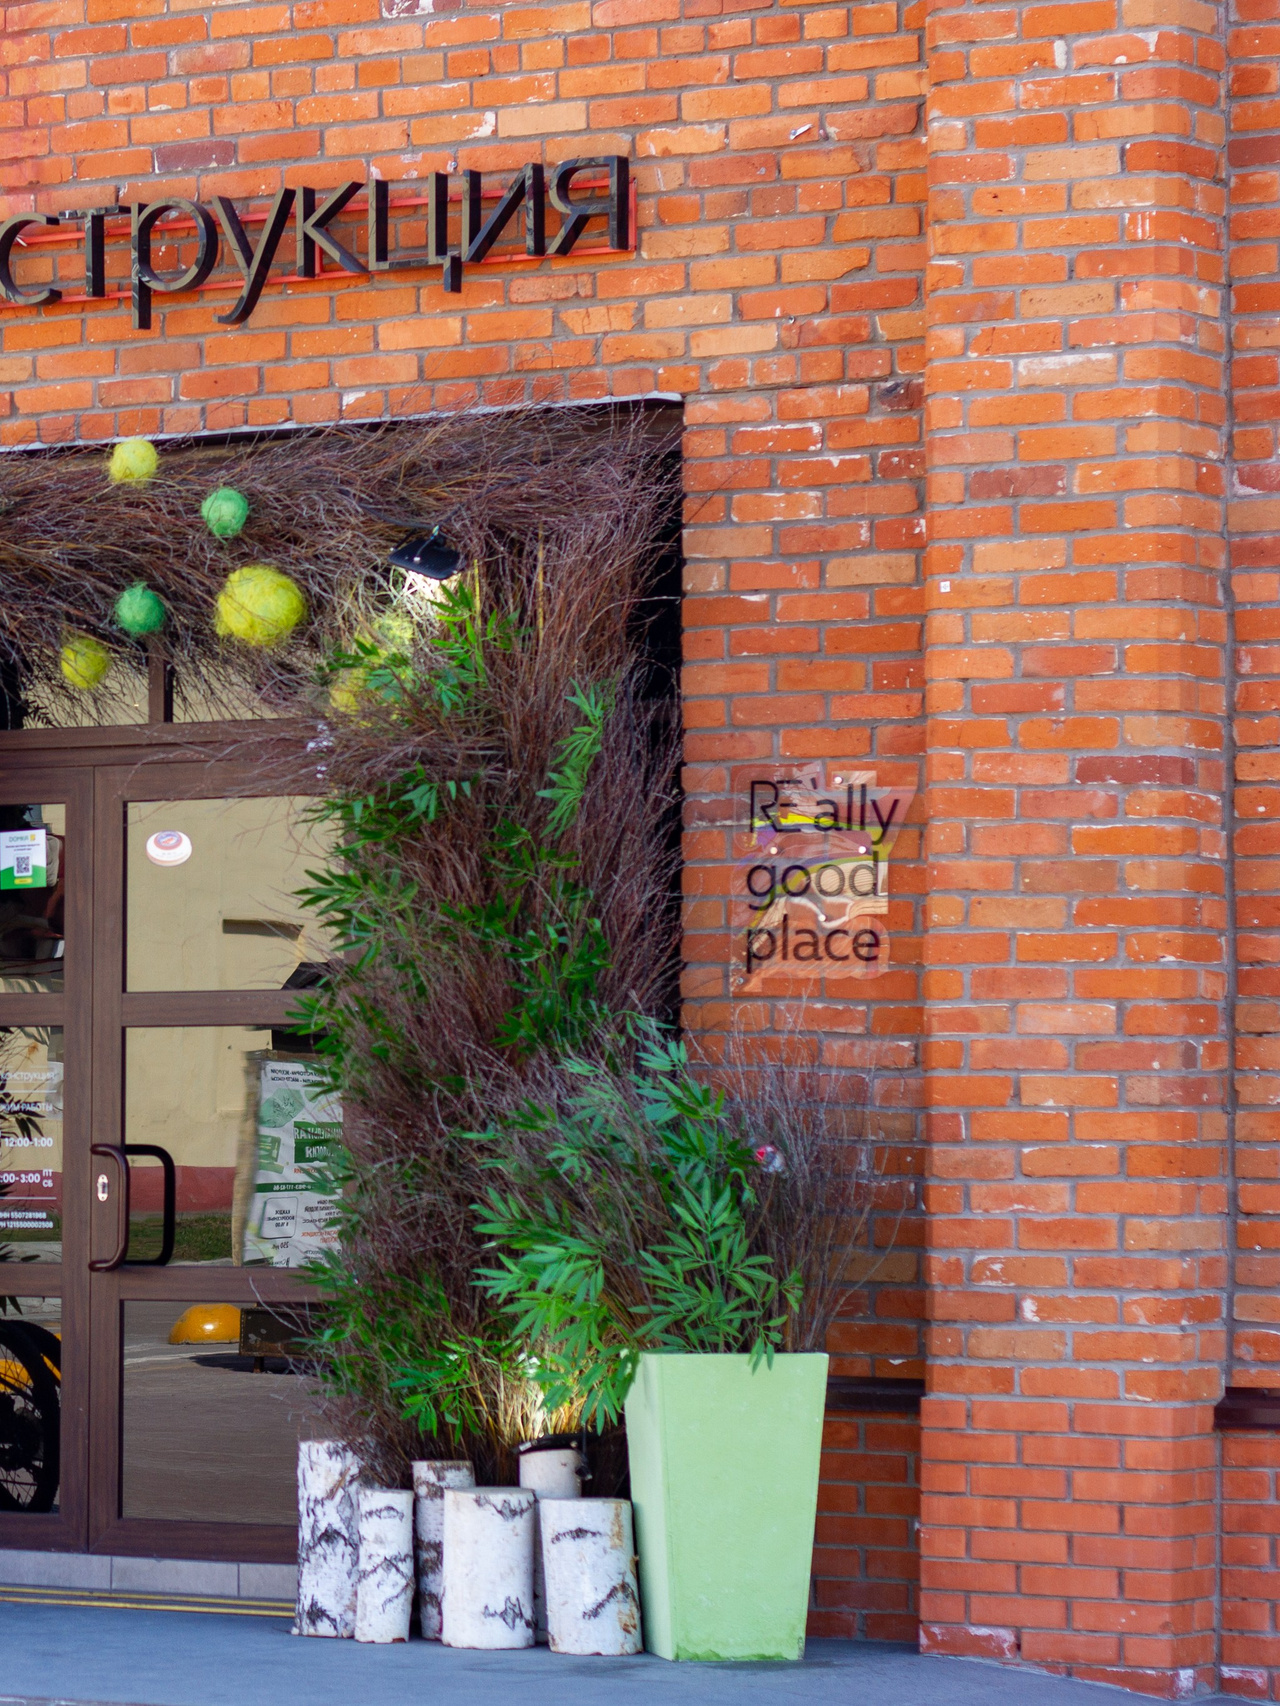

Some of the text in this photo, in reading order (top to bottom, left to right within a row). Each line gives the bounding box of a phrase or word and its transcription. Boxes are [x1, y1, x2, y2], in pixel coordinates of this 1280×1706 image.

[746, 850, 879, 911] good
[745, 913, 881, 974] place
[21, 1102, 53, 1111] РАБОТЫ
[4, 1137, 53, 1147] 12:00-1:00
[42, 1169, 53, 1177] ПТ
